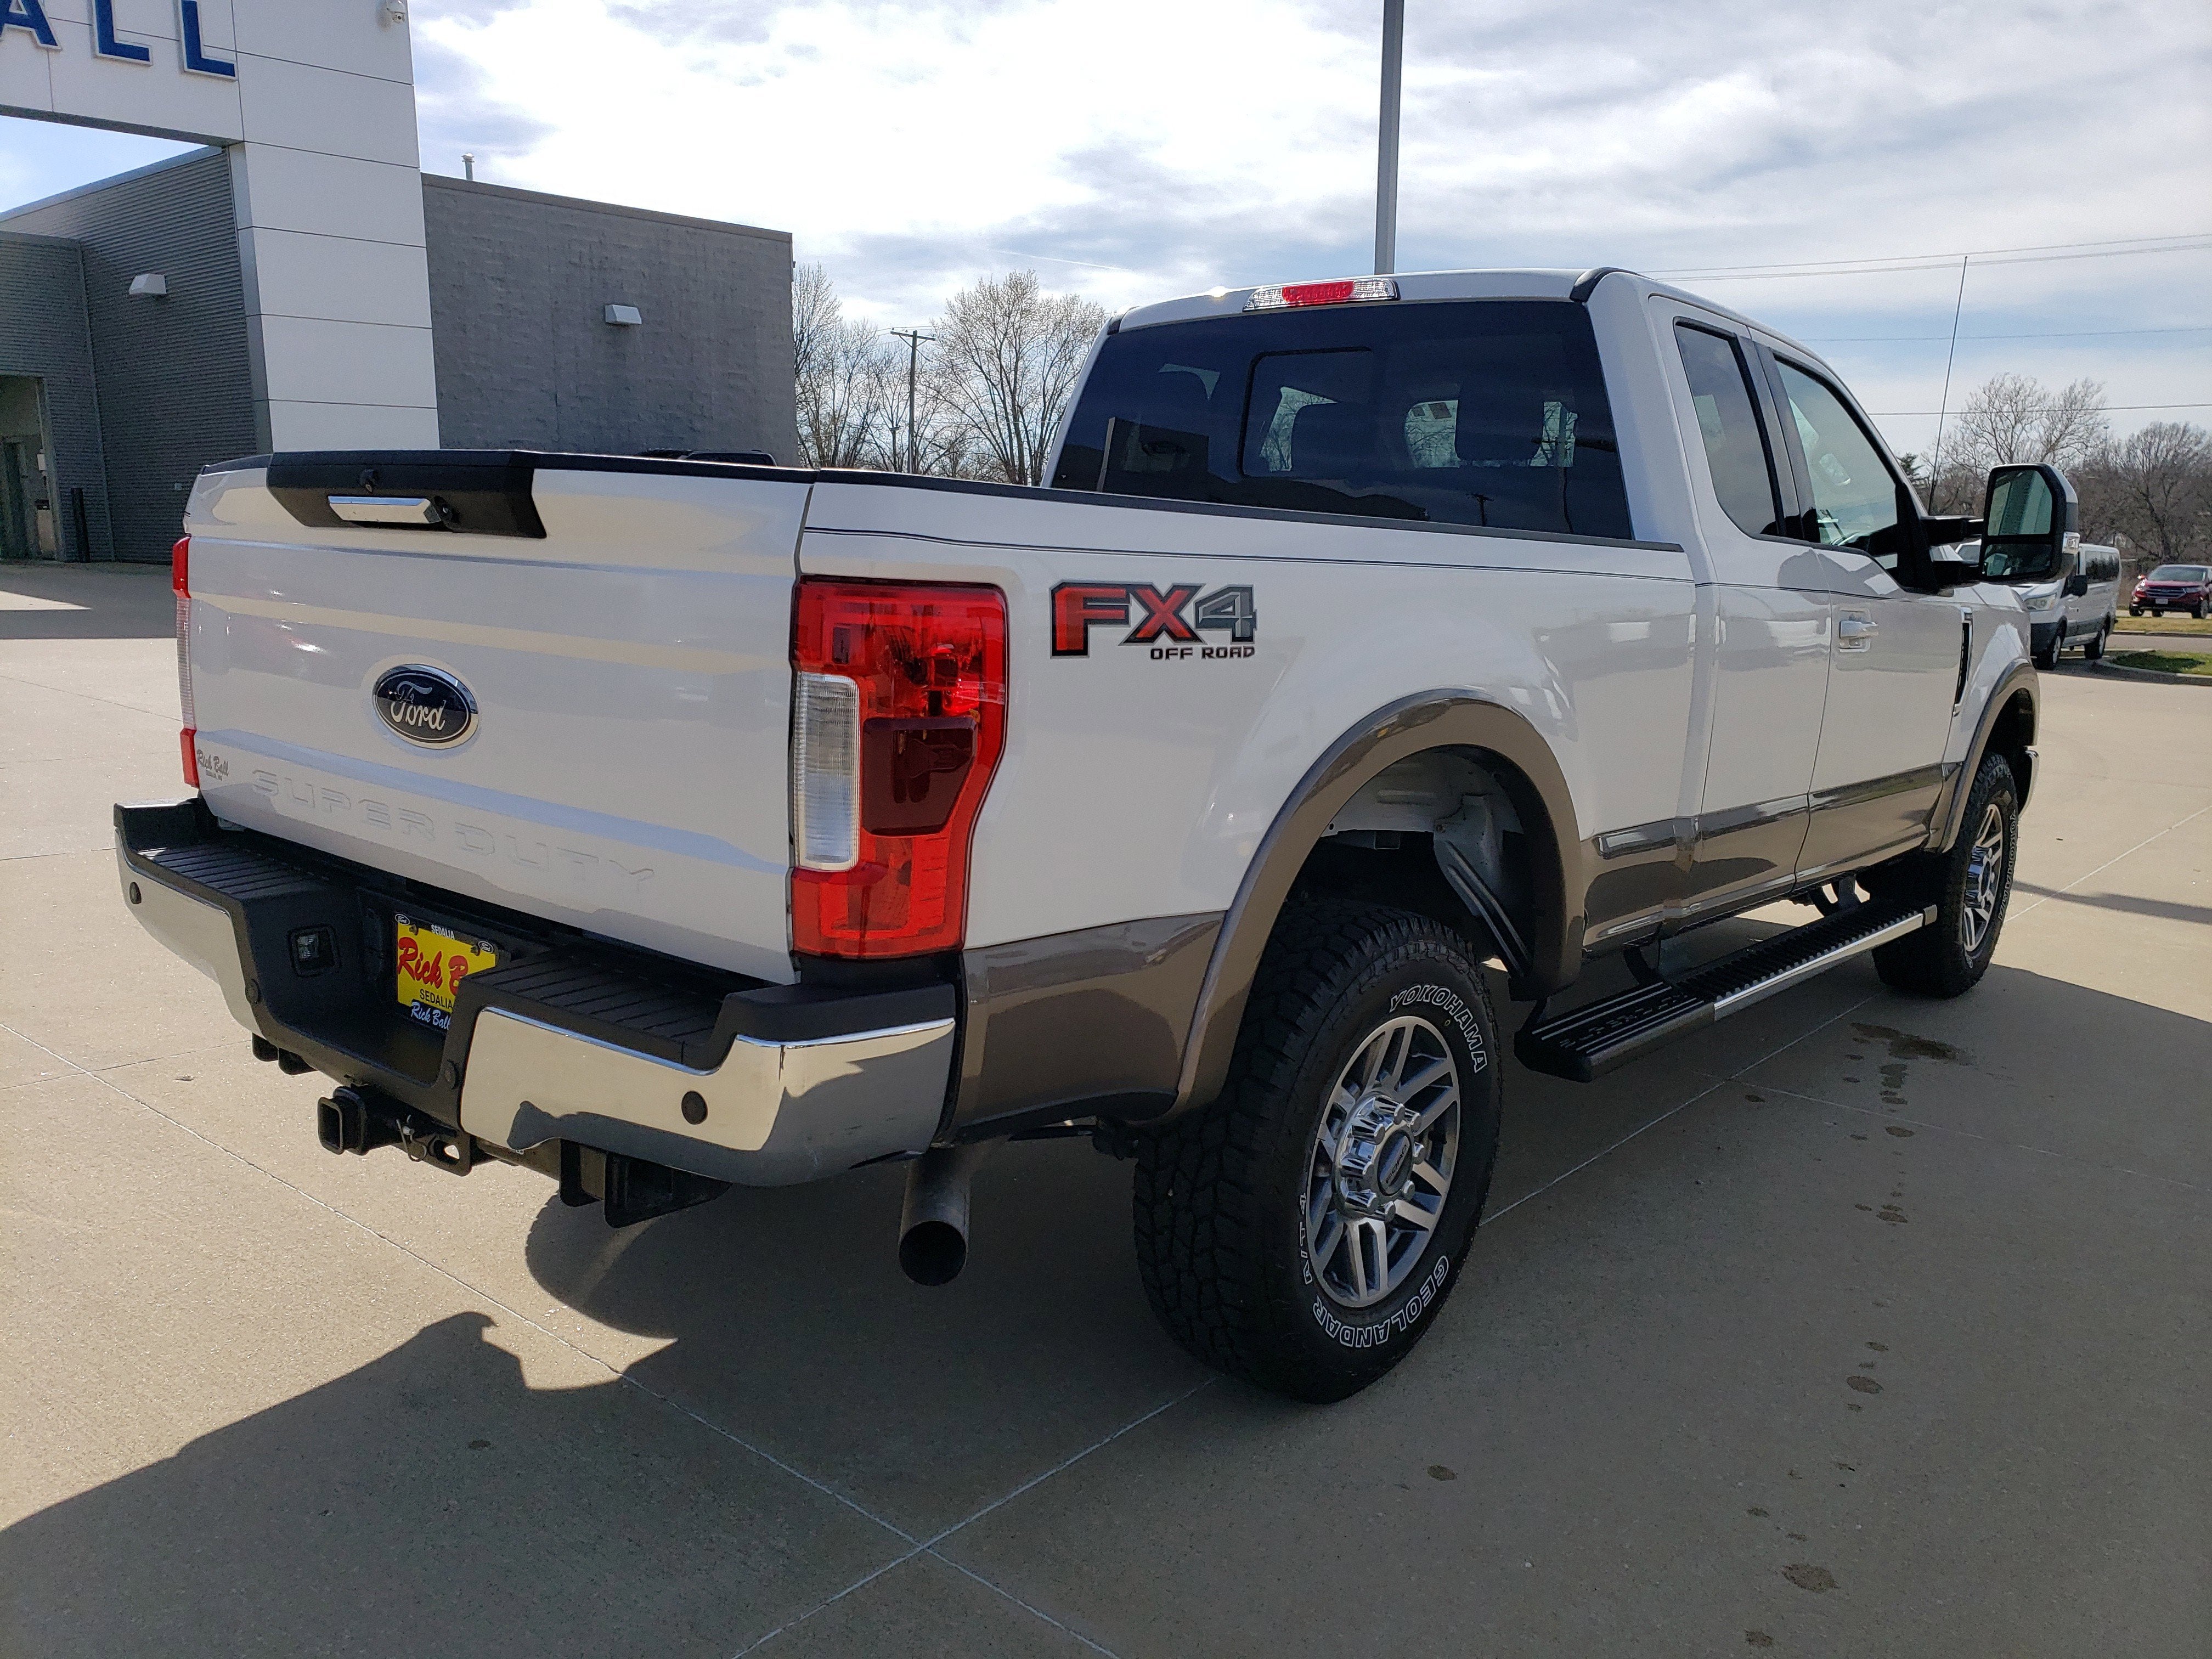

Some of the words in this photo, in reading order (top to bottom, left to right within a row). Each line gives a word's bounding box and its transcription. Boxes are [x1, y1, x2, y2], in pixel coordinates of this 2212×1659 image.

[1049, 579, 1257, 659] FX4
[1150, 646, 1193, 660] OFF
[1202, 646, 1255, 659] ROAD
[391, 681, 446, 730] Ford
[197, 749, 212, 770] Rick
[213, 755, 229, 776] Ball
[252, 770, 436, 840] SUPER
[454, 822, 655, 891] DUTY
[1998, 809, 2018, 921] YOKOHAMA
[431, 924, 455, 940] SEDALIA
[397, 936, 443, 989] Rick
[411, 1002, 431, 1023] Rick
[432, 1009, 450, 1030] Ball
[420, 989, 453, 1009] SEDALIA
[1389, 985, 1487, 1074] YOKOHAMA
[1386, 1144, 1407, 1184] FORD
[1313, 1255, 1449, 1348] GEOLANDAR
